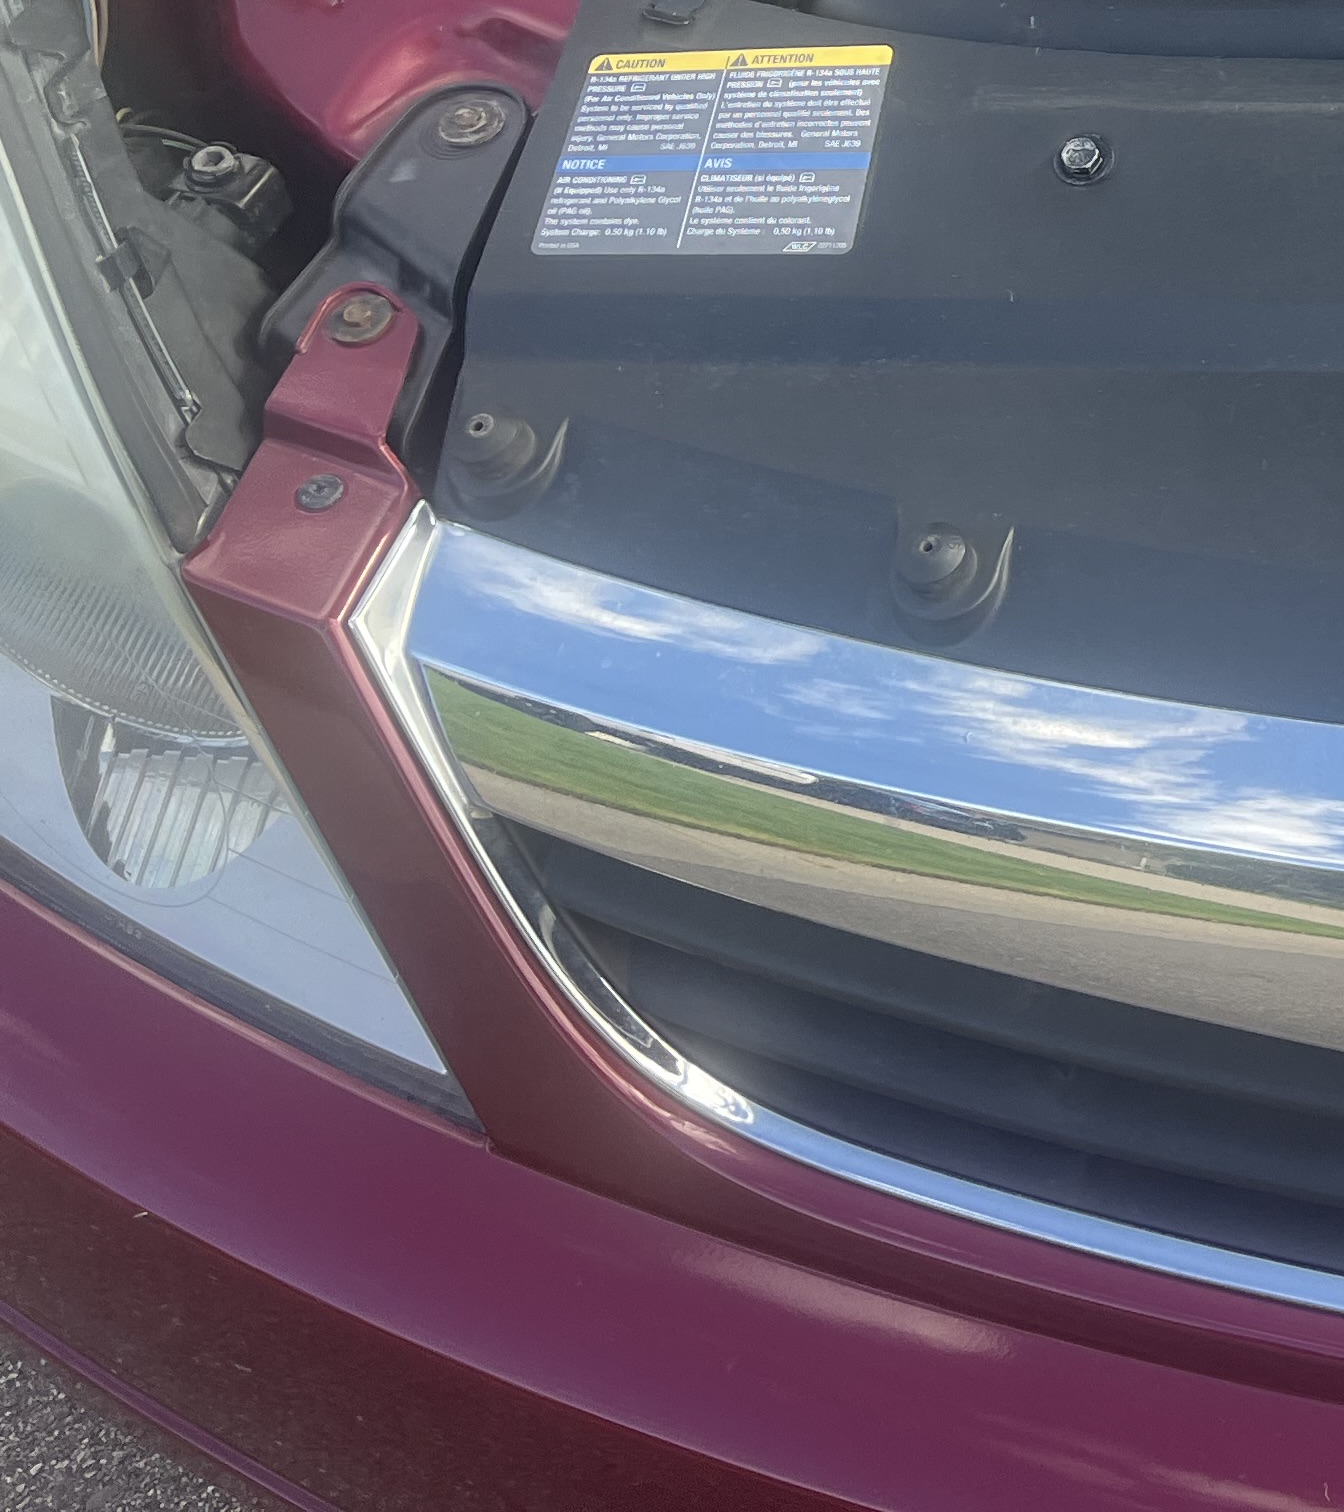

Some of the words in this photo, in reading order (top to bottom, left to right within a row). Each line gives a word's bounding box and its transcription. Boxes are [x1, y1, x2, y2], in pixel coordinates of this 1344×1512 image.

[616, 59, 666, 69] CAUTION
[752, 54, 814, 64] ATTENTION
[856, 68, 880, 76] HAUTE
[562, 159, 607, 170] NOTICE
[704, 158, 732, 168] AVIS
[541, 228, 569, 237] System
[624, 228, 633, 236] kg
[635, 228, 655, 236] (1.10
[657, 228, 667, 236] lb)
